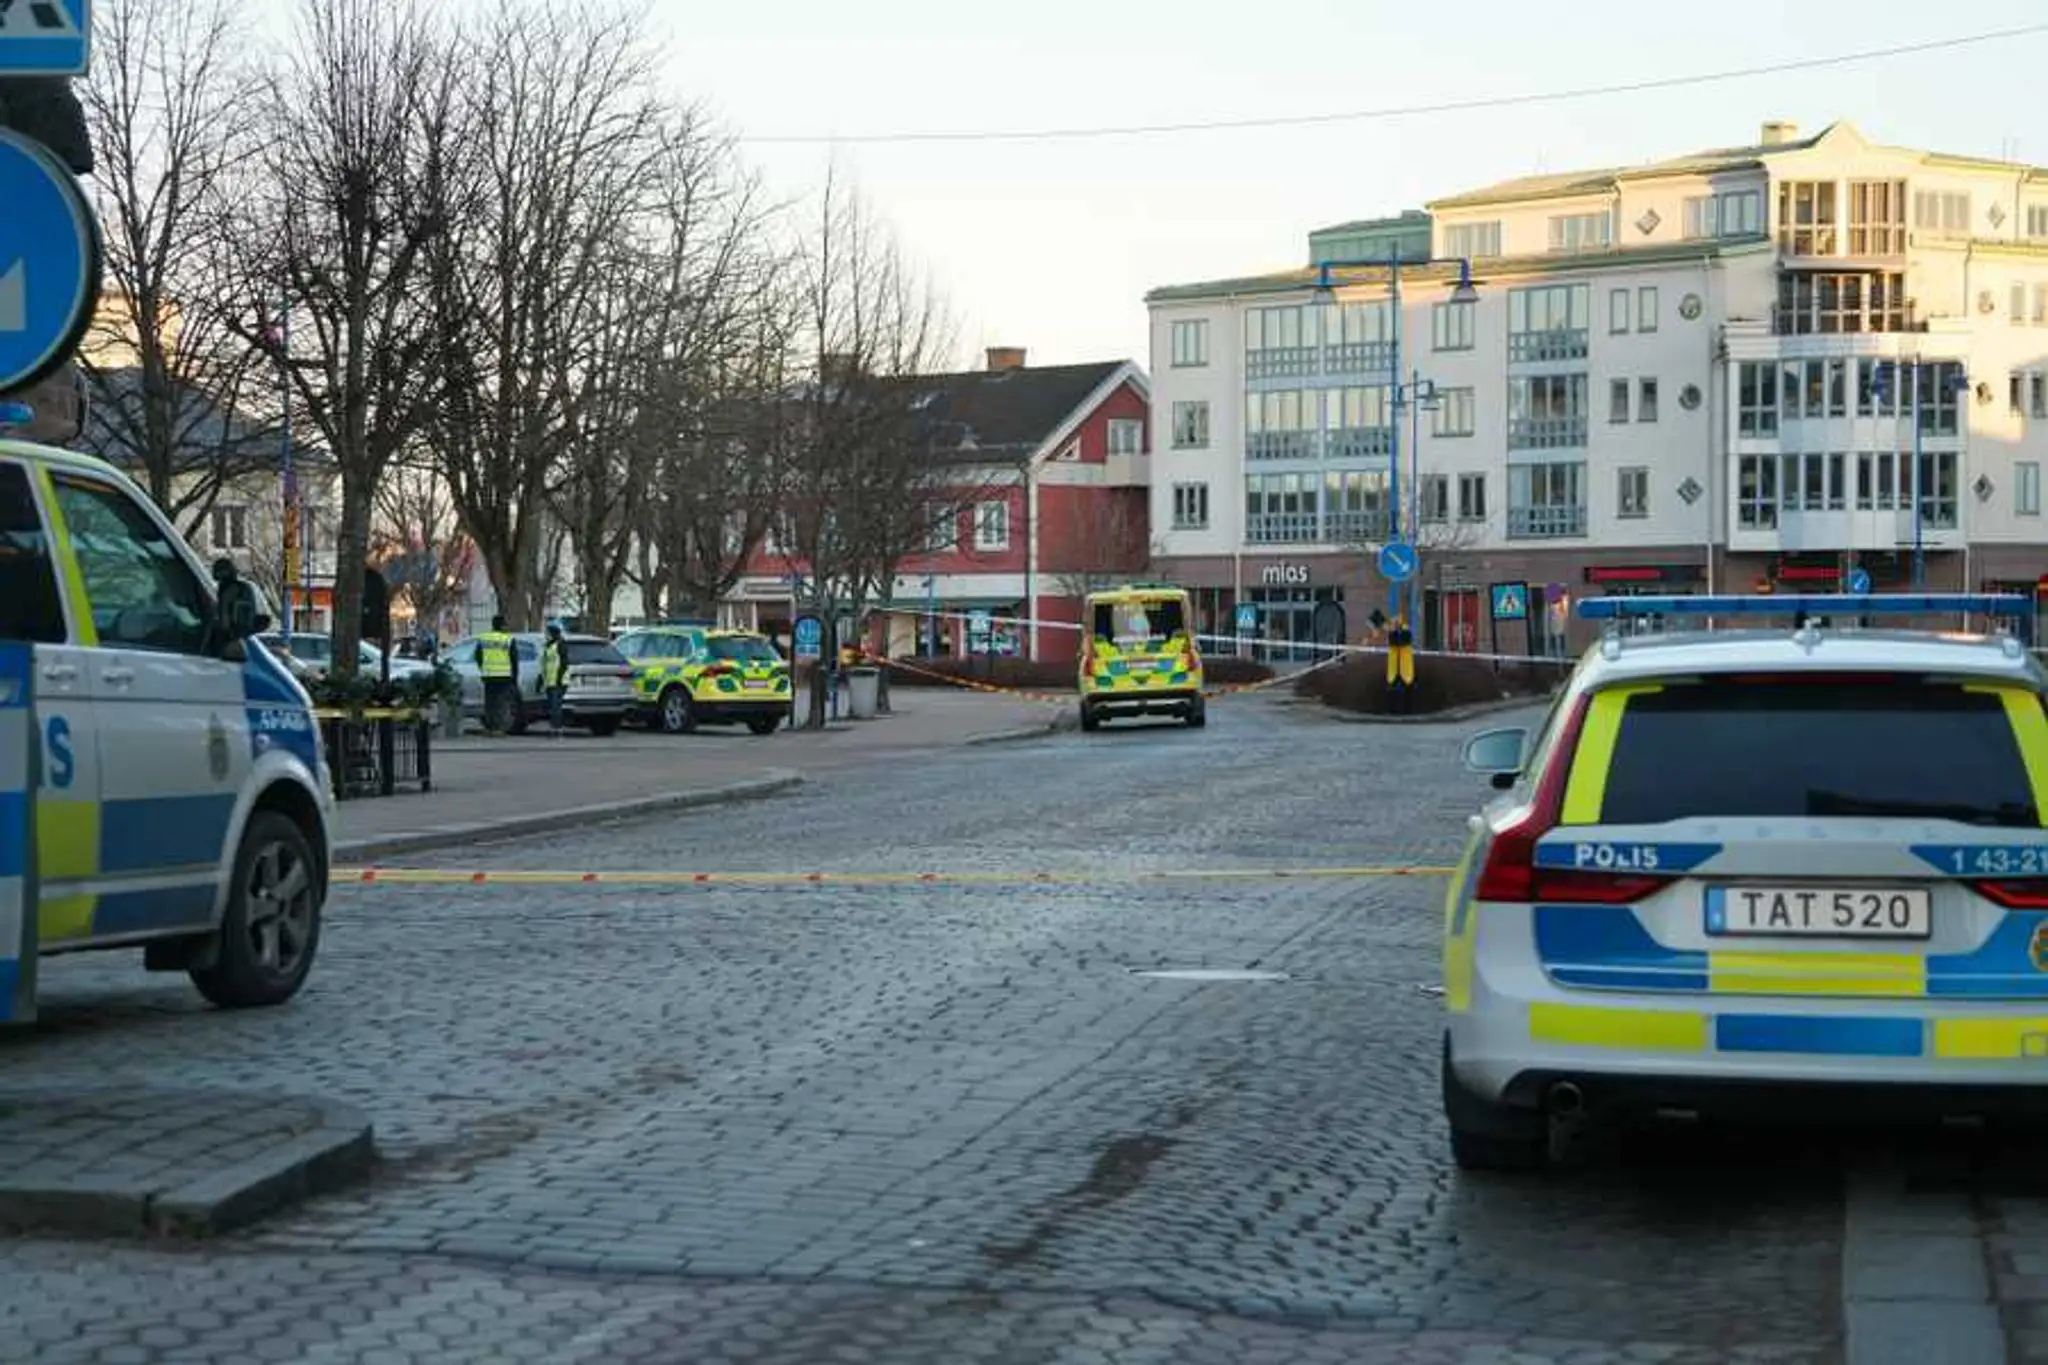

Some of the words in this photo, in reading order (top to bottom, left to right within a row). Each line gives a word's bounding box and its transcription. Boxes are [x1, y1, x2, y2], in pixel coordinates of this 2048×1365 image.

[1575, 843, 1659, 868] POLIS
[1952, 848, 1965, 872] 1
[1740, 891, 1818, 927] TAT
[1832, 892, 1911, 929] 520
